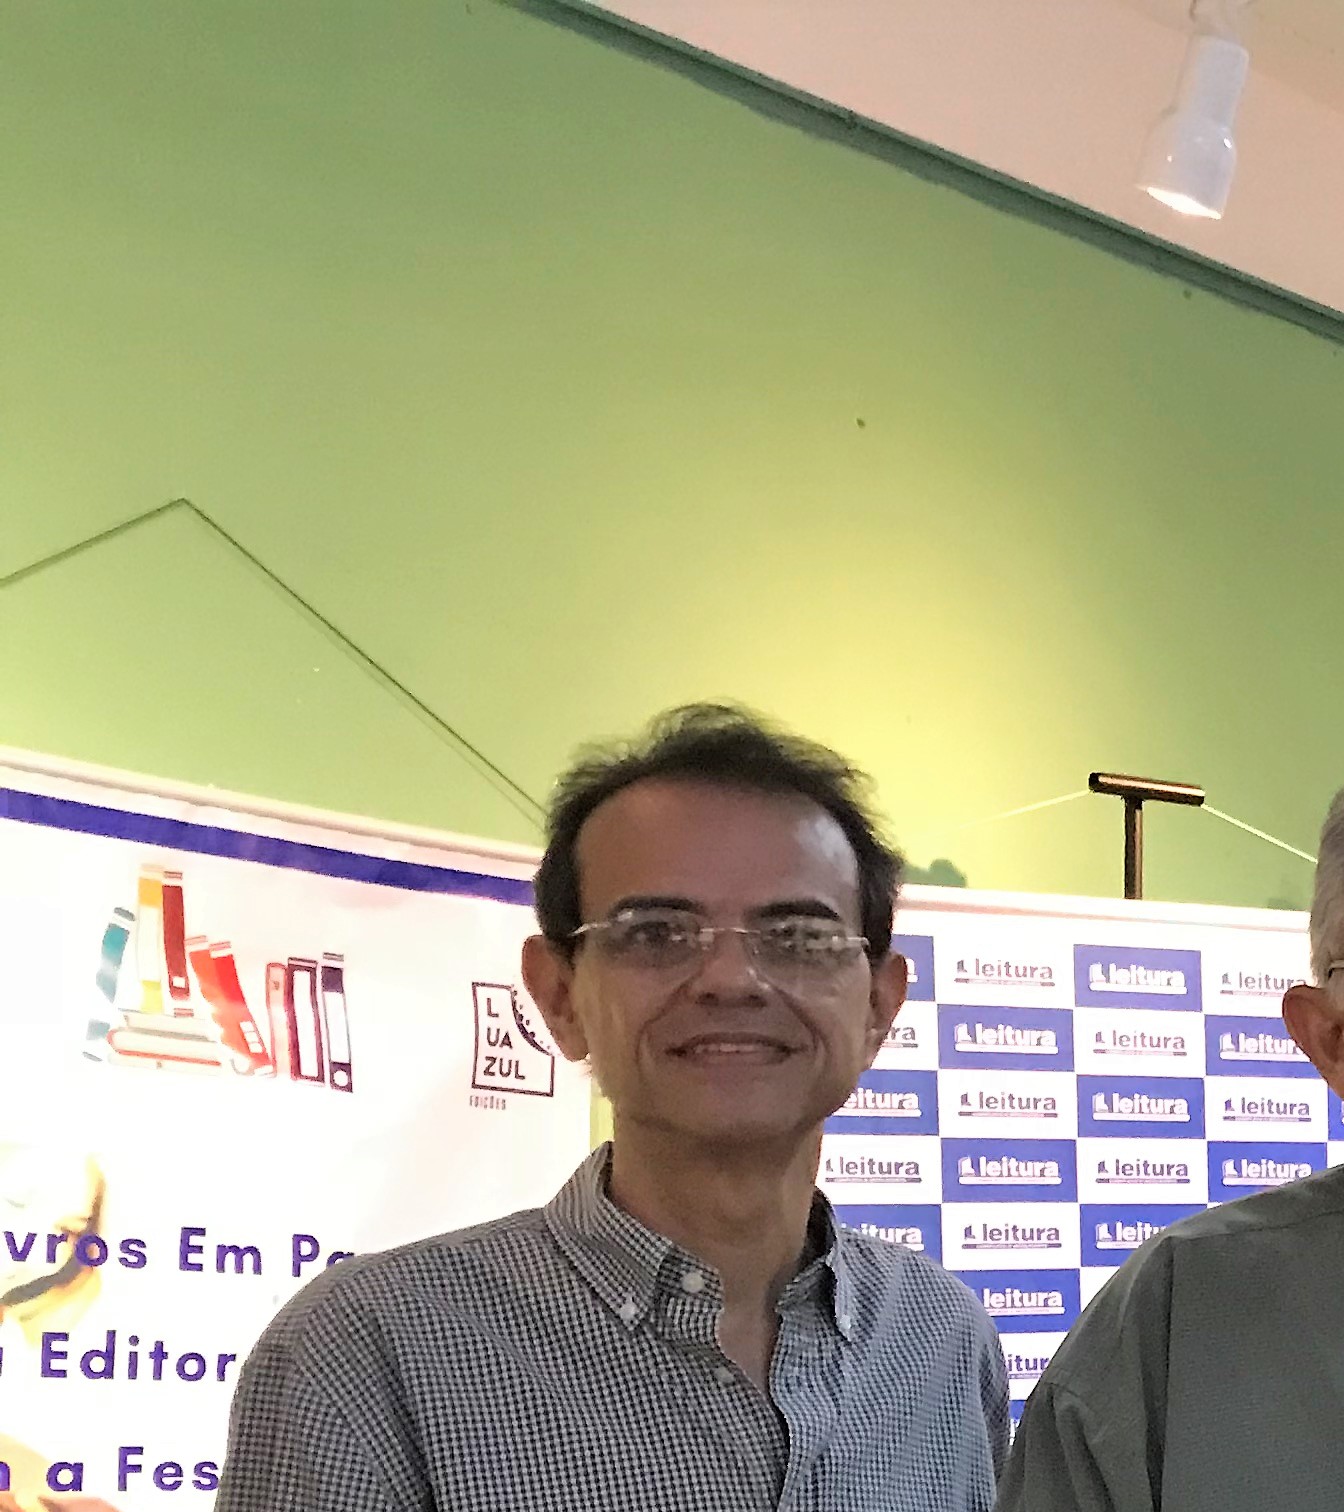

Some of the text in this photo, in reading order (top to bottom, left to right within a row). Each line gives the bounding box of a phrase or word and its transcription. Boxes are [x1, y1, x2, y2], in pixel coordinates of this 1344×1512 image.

[975, 958, 1053, 979] leitura
[1108, 963, 1186, 987] leitura
[486, 997, 499, 1018] L
[486, 1026, 513, 1050] UA
[975, 1023, 1057, 1046] leitura
[1112, 1030, 1186, 1050] leitura
[1238, 1032, 1303, 1055] leitur
[483, 1056, 526, 1081] ZUL
[847, 1088, 919, 1109] eitura
[979, 1091, 1057, 1110] leitura
[1112, 1092, 1188, 1114] leitura
[1241, 1097, 1311, 1116] leitura
[839, 1157, 920, 1176] leitura
[979, 1156, 1059, 1176] leitura
[1115, 1158, 1189, 1177] leitura
[1241, 1158, 1312, 1178] leitura
[983, 1223, 1060, 1241] leitura
[3, 1230, 149, 1270] vros
[179, 1227, 262, 1275] Em
[983, 1288, 1063, 1308] leitura
[41, 1330, 238, 1382] Editor
[1008, 1354, 1050, 1372] itur
[46, 1461, 84, 1492] a
[117, 1446, 219, 1492] Fes
